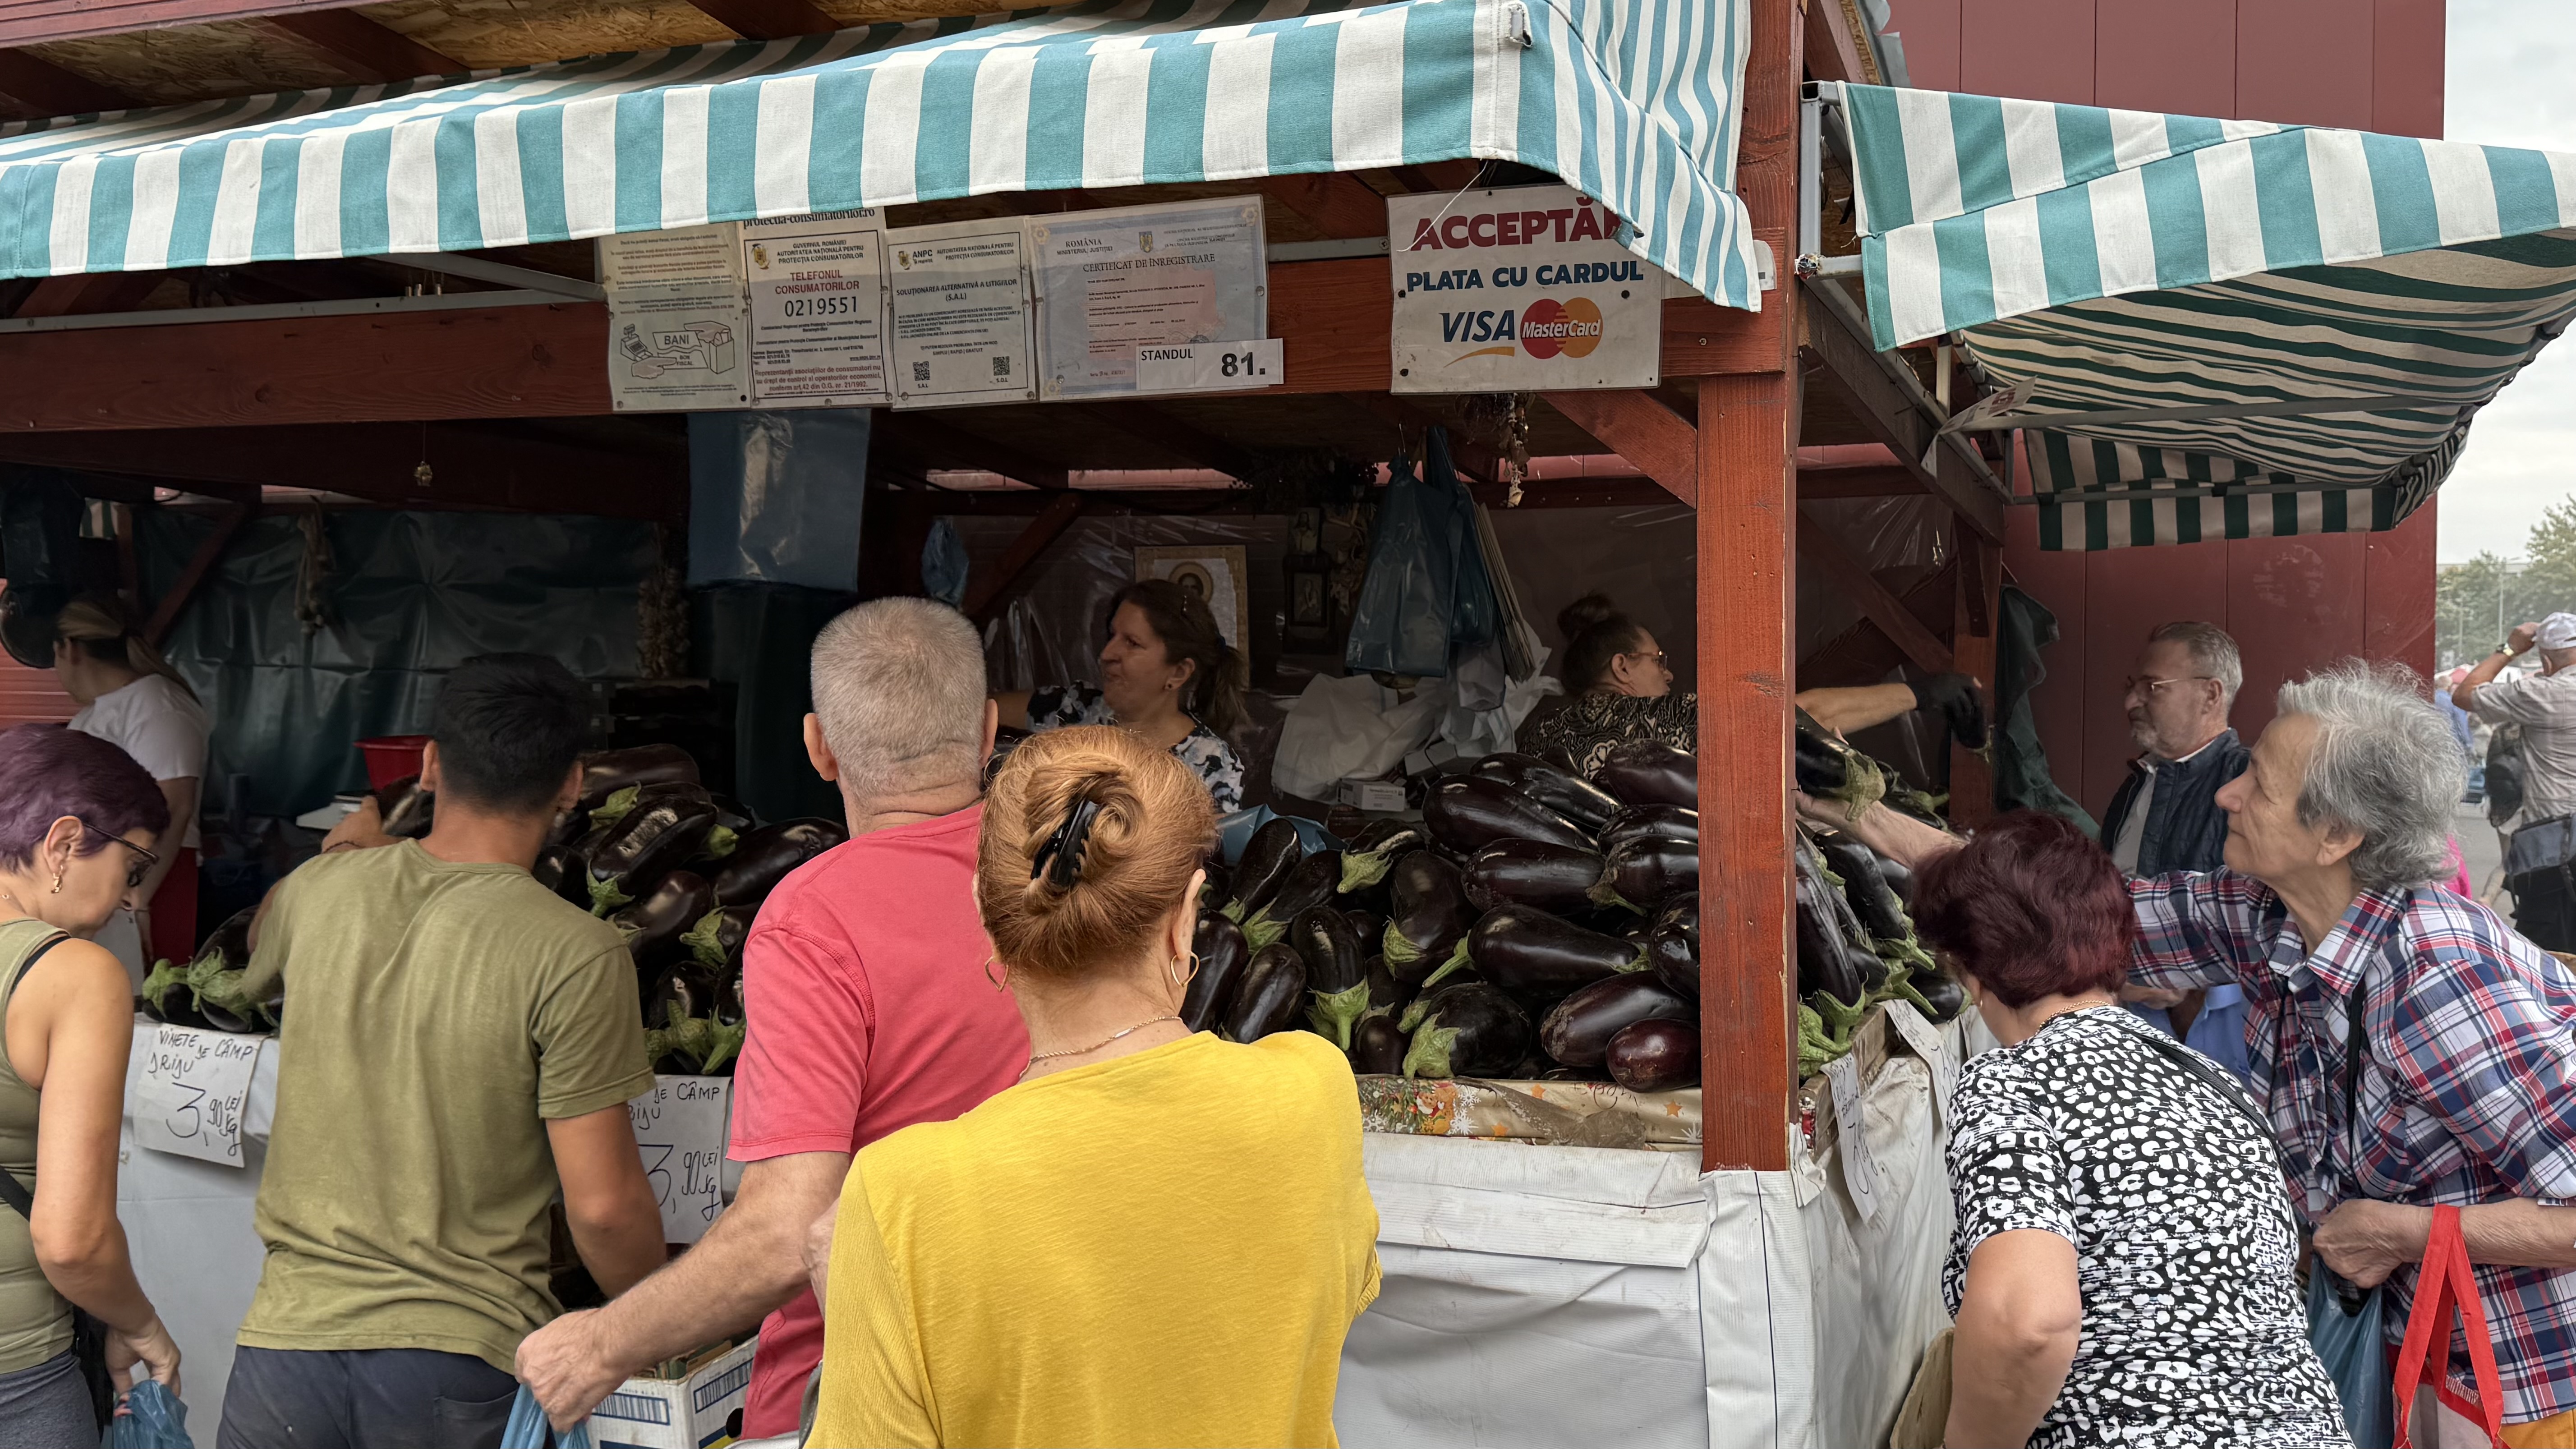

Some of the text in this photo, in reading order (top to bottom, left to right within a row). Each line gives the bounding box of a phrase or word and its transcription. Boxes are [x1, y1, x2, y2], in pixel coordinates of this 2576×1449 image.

[1066, 237, 1102, 248] ROMÂNIA
[810, 253, 864, 262] CONSUMATORILOR
[913, 249, 933, 258] ANPC
[1083, 254, 1215, 272] CERTIFICAT DE ÎNREGISTRARE
[790, 270, 843, 281] TELEFONUL
[1407, 260, 1644, 292] PLATA CU CARDUL
[775, 281, 859, 294] CONSUMATORILOR
[897, 285, 939, 296] SOLUȚIONAREA
[941, 281, 979, 291] ALTERNATIVĂ
[986, 279, 1017, 288] LITIGIILOR
[785, 296, 857, 317] 0219551
[1439, 310, 1515, 343] VISA
[1521, 319, 1601, 339] MasterCard
[664, 335, 689, 345] BANI
[1141, 349, 1193, 361] STANDUL
[1221, 352, 1266, 377] 81.
[160, 1028, 199, 1048] VINETE
[215, 1038, 253, 1061] CÂMP
[677, 1081, 720, 1101] CÂMP
